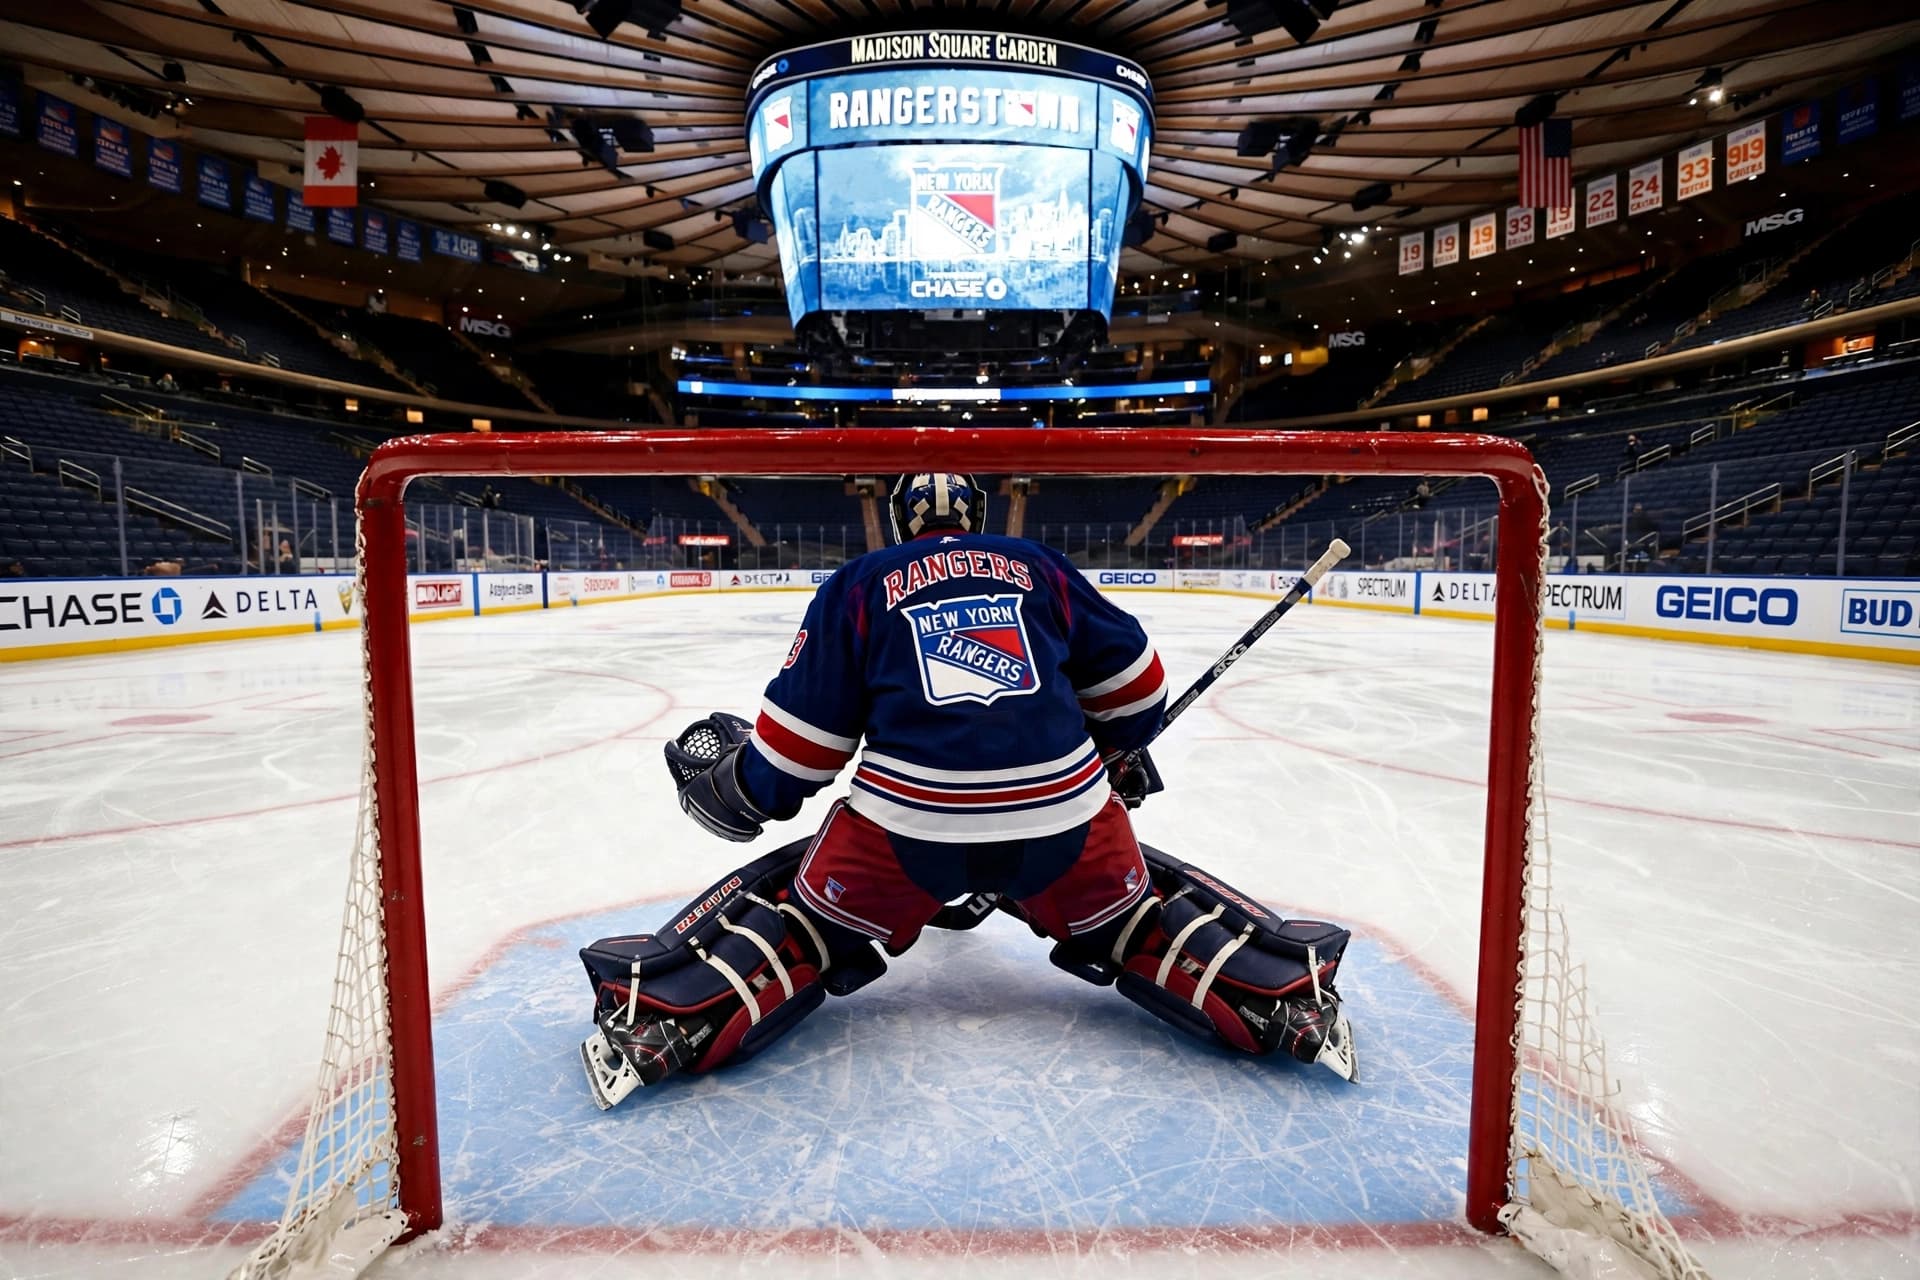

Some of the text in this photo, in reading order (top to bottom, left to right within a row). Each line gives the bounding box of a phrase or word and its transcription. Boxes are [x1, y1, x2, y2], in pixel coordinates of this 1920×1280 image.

[851, 31, 1057, 67] MADISON SQUARE GARDEN
[954, 172, 993, 190] YORK
[1679, 157, 1710, 184] 33
[1631, 174, 1660, 200] 24
[1588, 188, 1615, 213] 22
[926, 194, 990, 249] RANGERS
[1745, 208, 1804, 236] MSG
[1436, 235, 1456, 255] 19
[1473, 225, 1493, 246] 19
[1403, 243, 1421, 262] 19
[911, 280, 985, 298] CHASE
[459, 316, 512, 338] MSG
[1328, 331, 1366, 349] MSG
[883, 550, 1034, 612] RANGERS
[1099, 572, 1156, 584] GEICO
[1357, 577, 1406, 599] SPECTRUM
[237, 588, 318, 613] DELTA
[1545, 584, 1622, 610] PECTRUM
[1656, 585, 1799, 626] GEICO
[918, 608, 959, 634] NEW
[1848, 597, 1913, 627] BUD
[937, 636, 1023, 682] RANGERS
